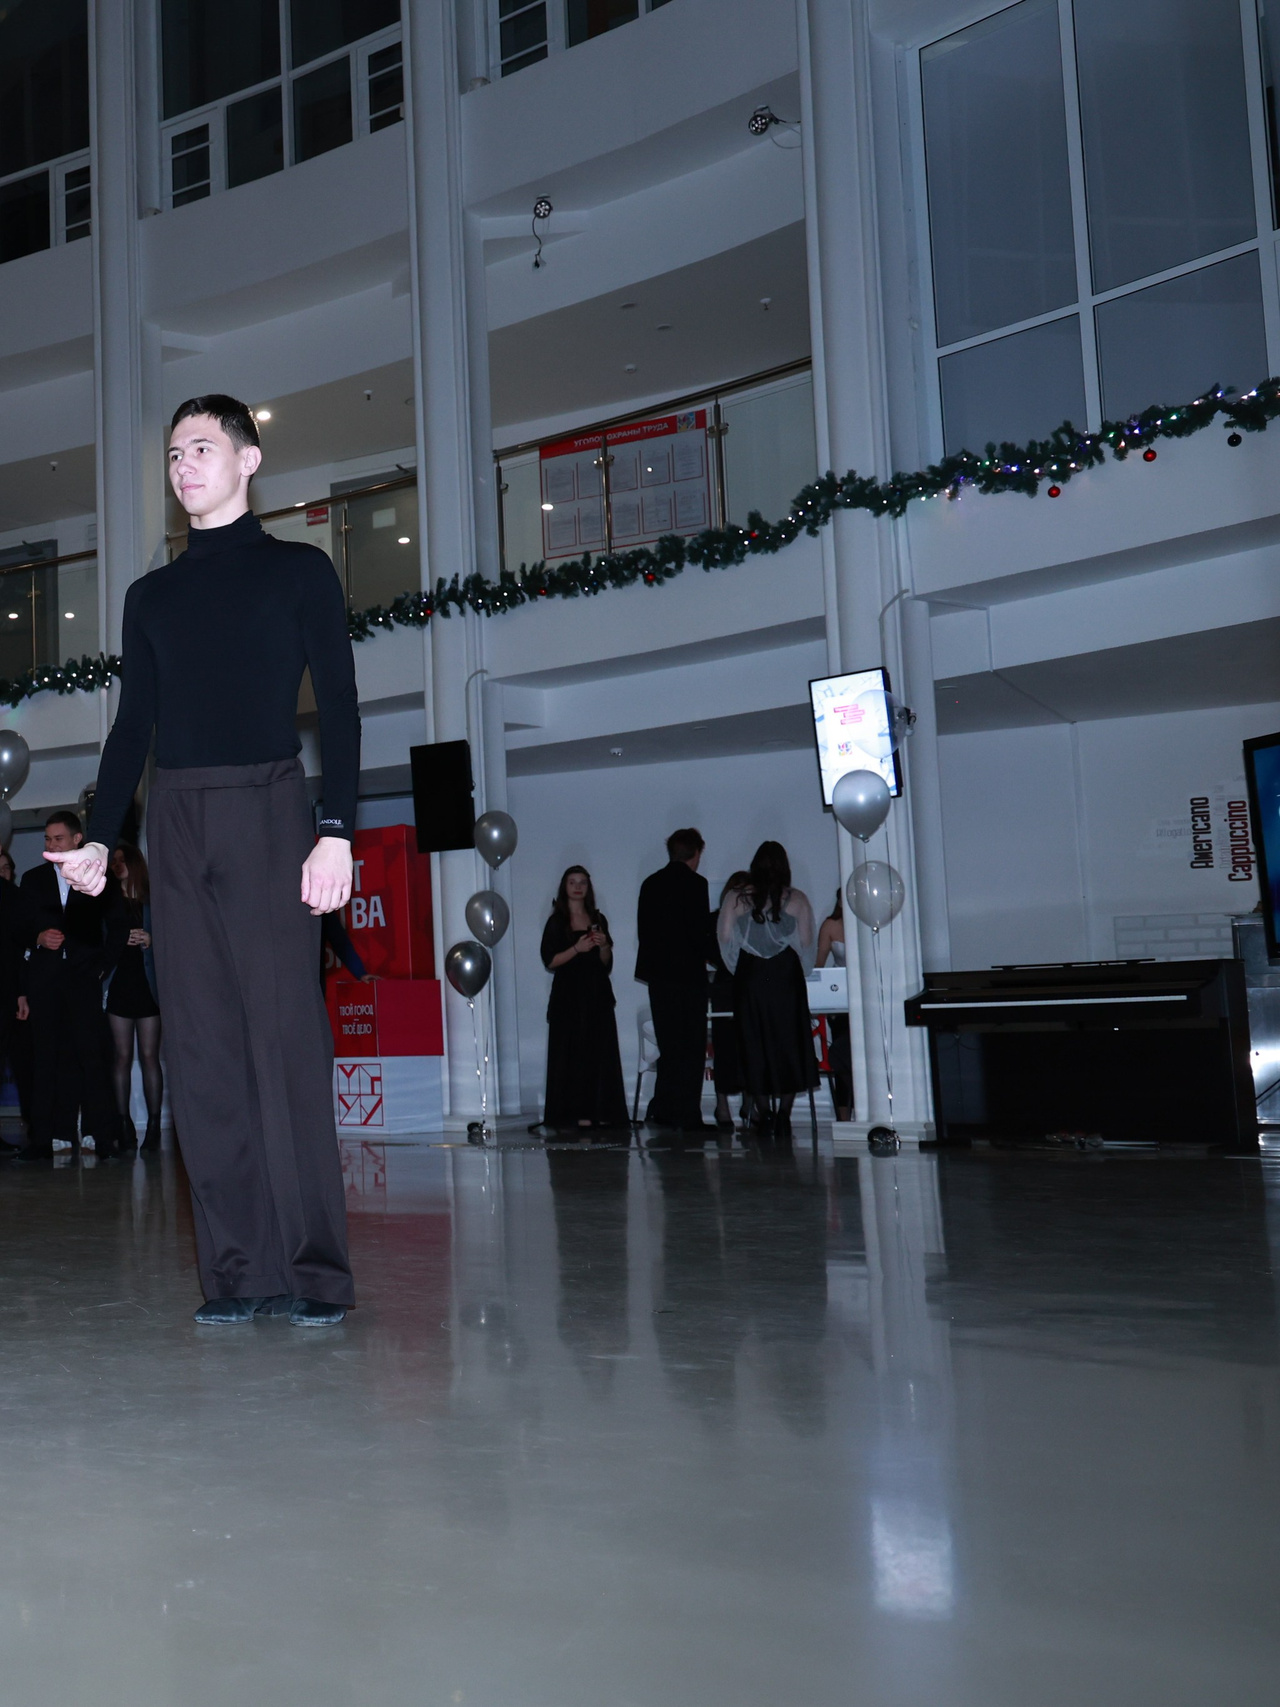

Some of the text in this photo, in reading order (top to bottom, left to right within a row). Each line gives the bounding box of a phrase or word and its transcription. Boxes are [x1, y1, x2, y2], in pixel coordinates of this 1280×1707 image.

[606, 428, 640, 440] ОХРАНЫ
[643, 422, 669, 432] ТРУДА
[1224, 800, 1256, 882] Cappuccino
[339, 1003, 373, 1016] ТВОЙ ГОРОД
[357, 1024, 372, 1036] ДЕЛО
